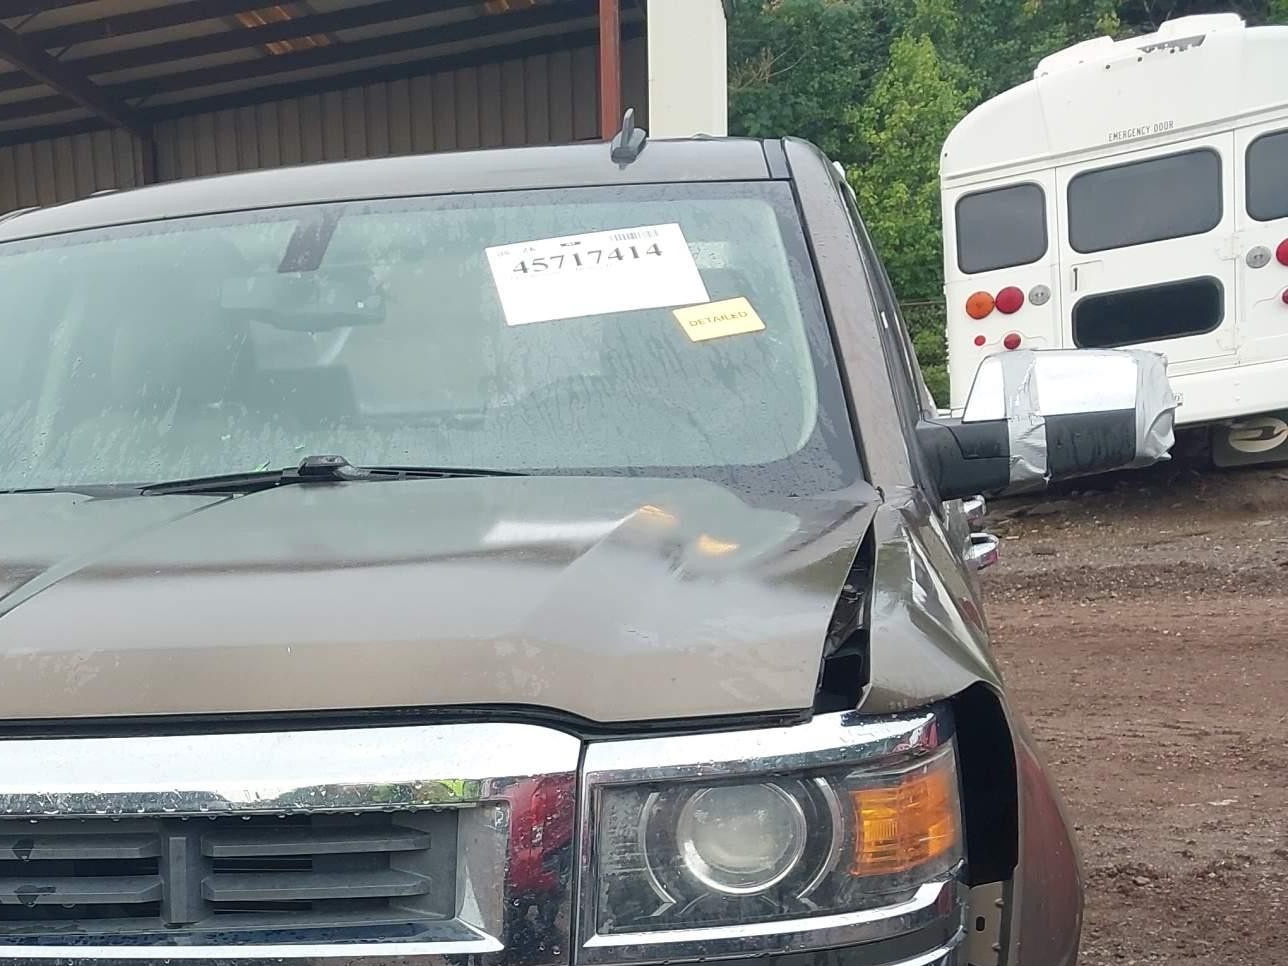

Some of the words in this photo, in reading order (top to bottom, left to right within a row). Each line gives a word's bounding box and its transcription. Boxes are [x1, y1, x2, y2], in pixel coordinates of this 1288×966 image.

[1108, 125, 1150, 142] EMERGENCY
[1153, 120, 1174, 132] DOOR
[512, 243, 663, 274] 45717414
[688, 311, 748, 327] DETAILED
